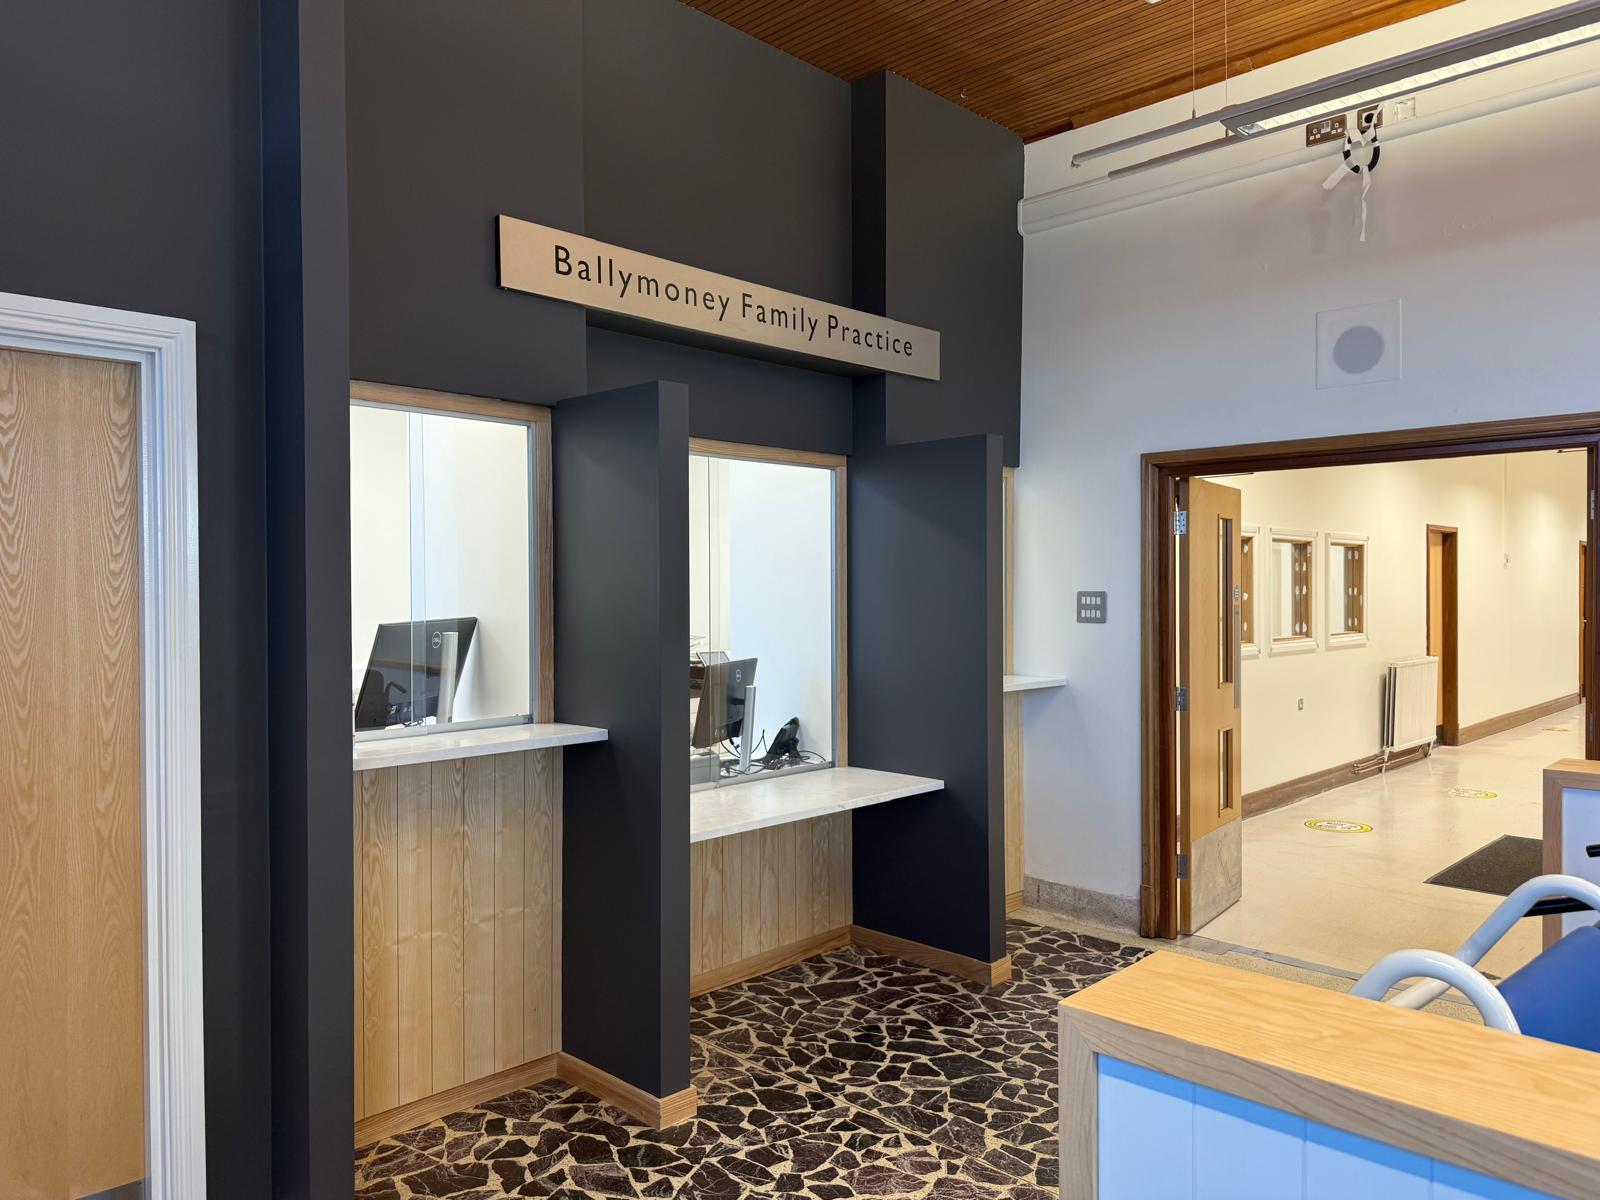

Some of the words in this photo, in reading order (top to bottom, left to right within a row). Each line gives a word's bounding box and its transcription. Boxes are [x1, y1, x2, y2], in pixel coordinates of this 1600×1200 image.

[554, 244, 730, 321] Ballymoney
[741, 292, 818, 341] Family
[828, 314, 914, 357] Practice
